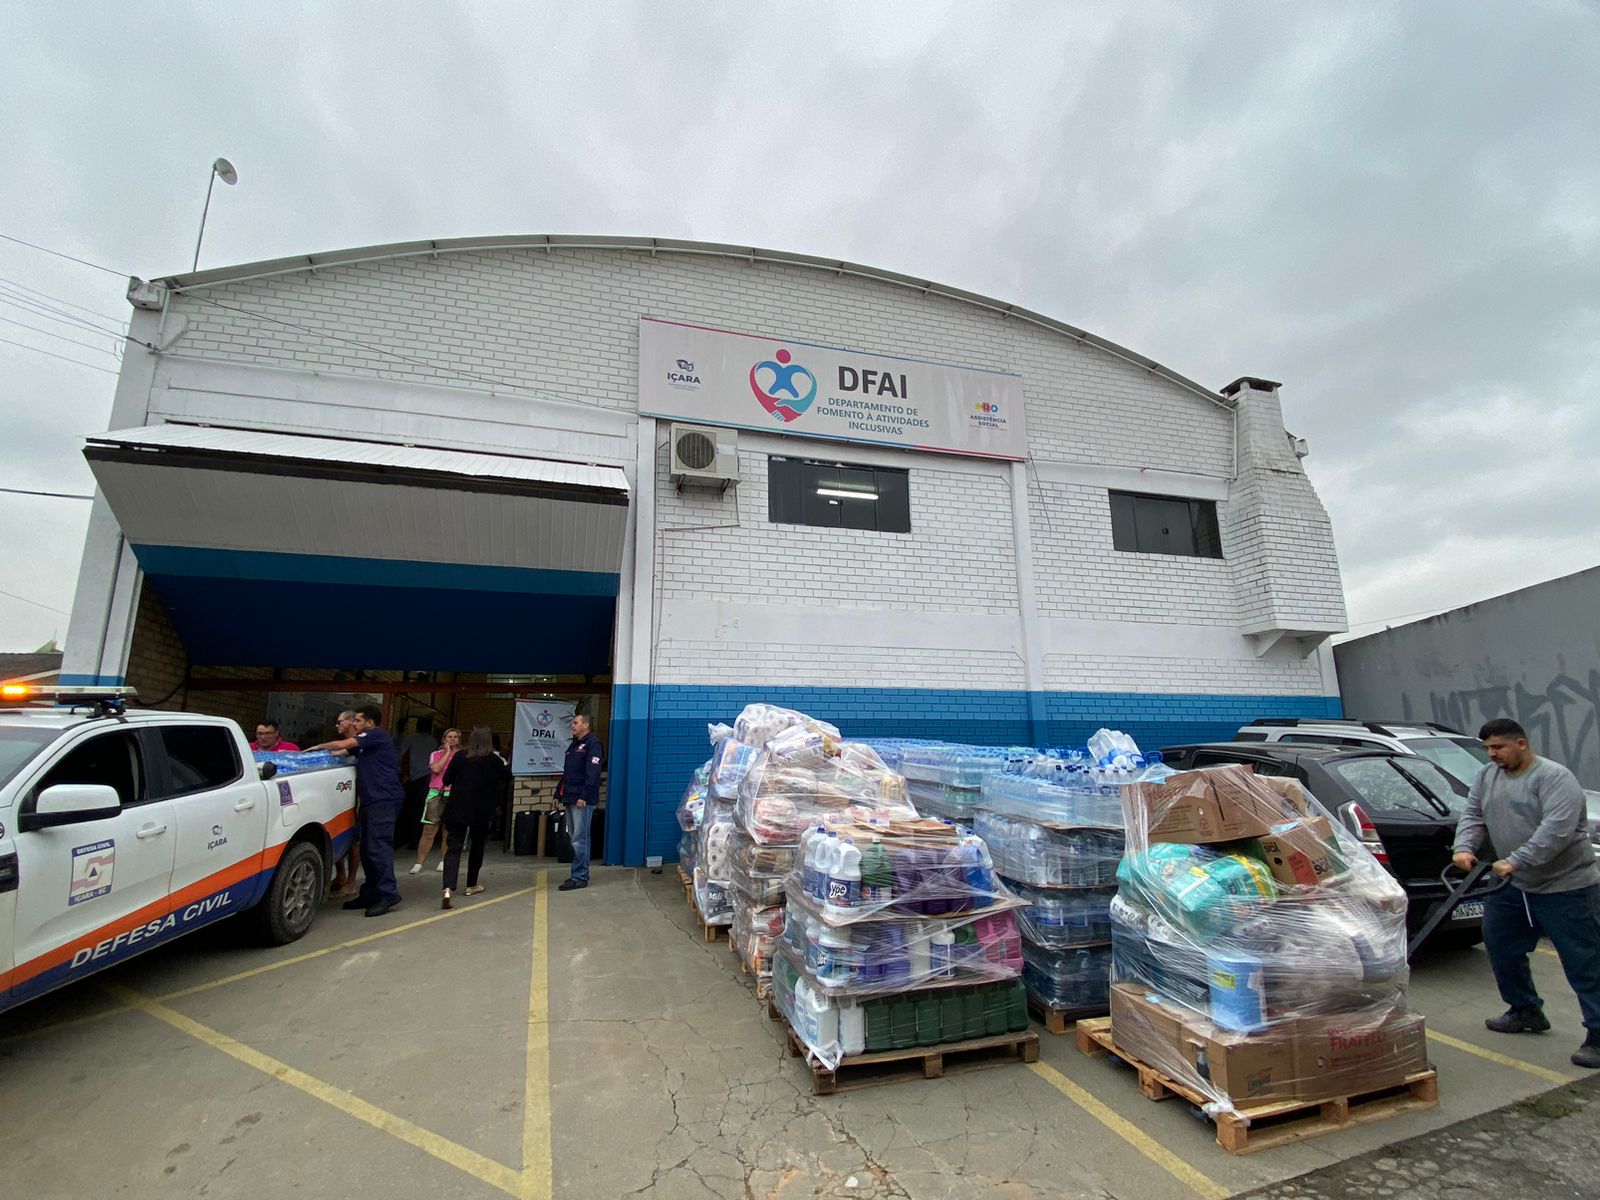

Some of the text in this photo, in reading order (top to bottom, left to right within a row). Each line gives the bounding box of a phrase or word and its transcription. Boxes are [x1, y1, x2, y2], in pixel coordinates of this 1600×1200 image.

[667, 372, 701, 384] IÇARA
[838, 365, 907, 399] DFAI
[828, 397, 919, 416] DEPARTAMENTO DE
[817, 406, 930, 428] FOMENTO À ATIVIDADES
[848, 421, 903, 435] INCLUSIVAS
[531, 728, 556, 739] DFAI
[70, 892, 232, 969] DEFESA CIVIL
